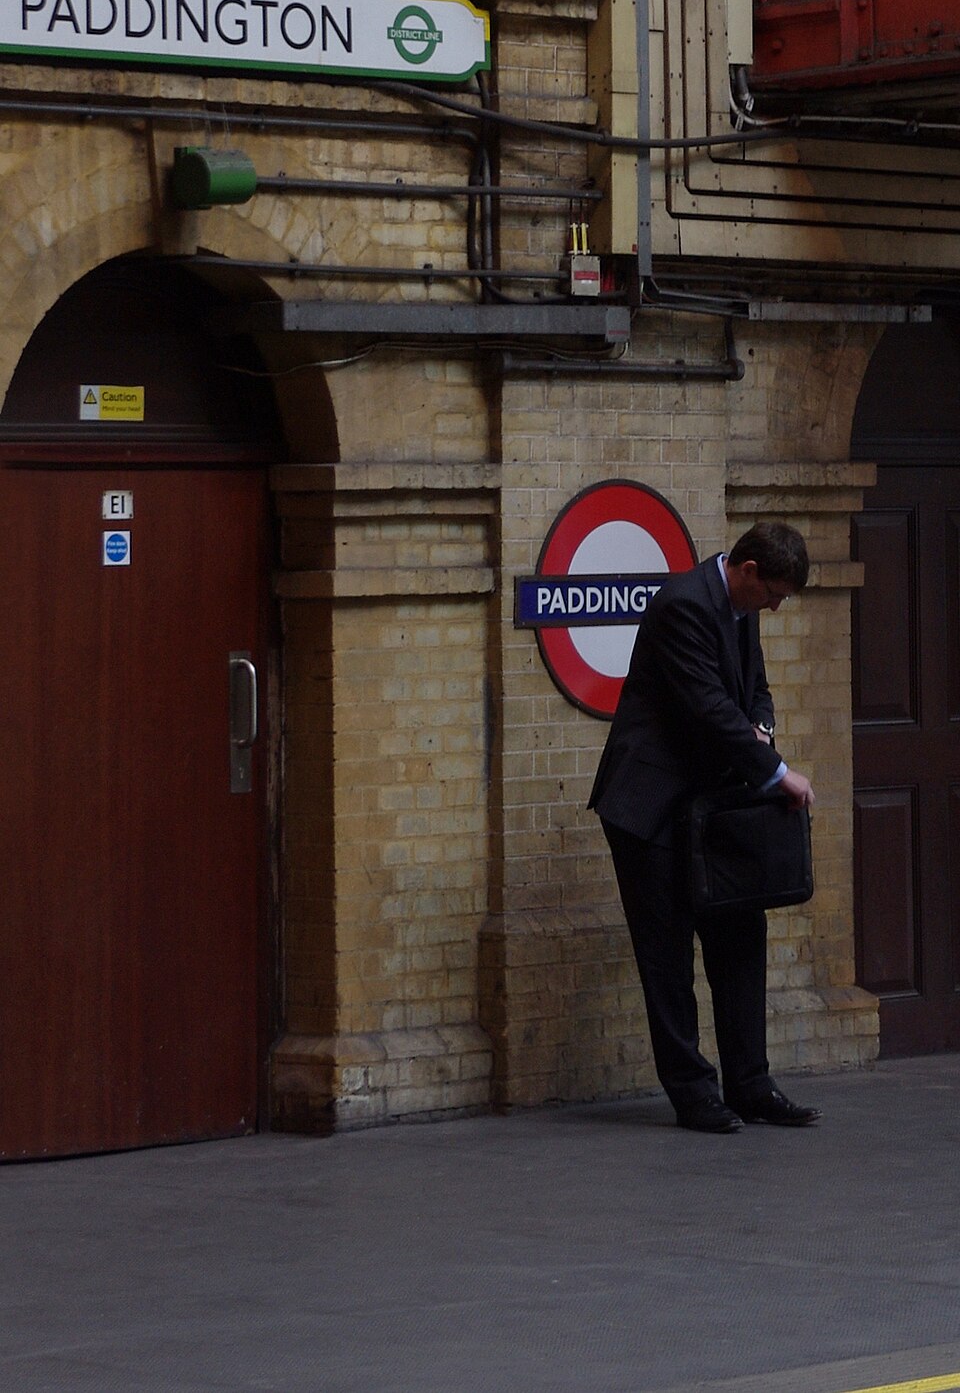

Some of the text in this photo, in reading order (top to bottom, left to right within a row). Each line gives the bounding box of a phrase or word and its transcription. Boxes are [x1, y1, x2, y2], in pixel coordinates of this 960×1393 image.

[391, 29, 440, 41] DISTRICT LINE
[102, 391, 138, 402] Caution
